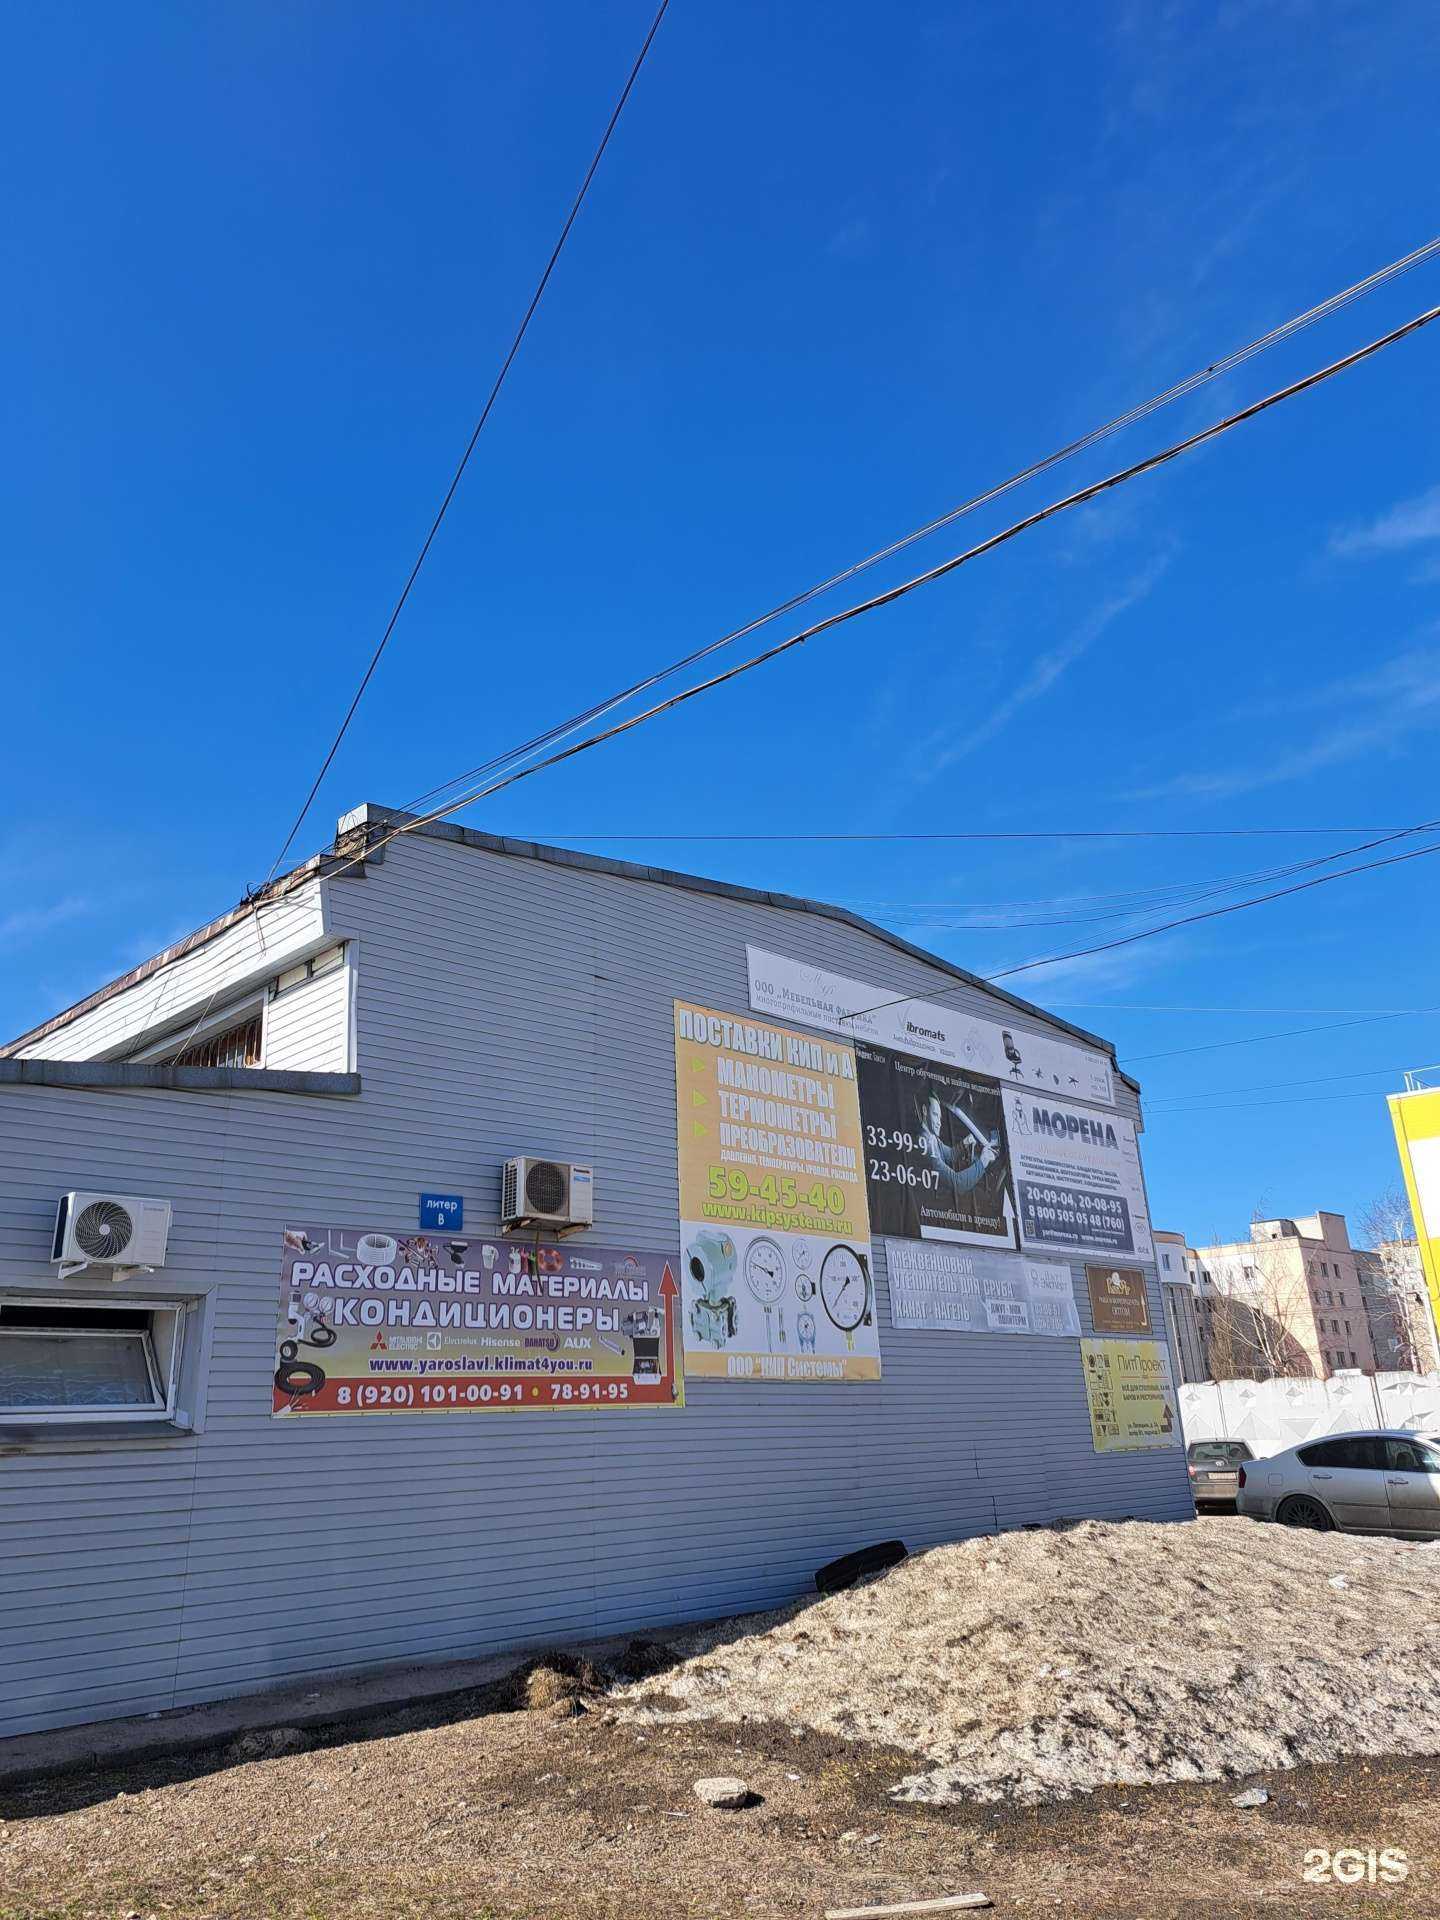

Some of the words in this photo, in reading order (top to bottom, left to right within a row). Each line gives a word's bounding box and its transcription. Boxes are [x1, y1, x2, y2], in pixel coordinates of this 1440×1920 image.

[679, 1008, 784, 1062] ПОСТАВКИ
[787, 1037, 823, 1073] КИП
[841, 1053, 854, 1081] А
[894, 1061, 916, 1077] Центр
[717, 1057, 835, 1110] МАНОМЕТРЫ
[718, 1090, 838, 1140] ТЕРМОМЕТРЫ
[1032, 1106, 1119, 1149] МОРЕНА
[719, 1122, 857, 1170] ПРЕОБРАЗОВАТЕЛИ
[866, 1125, 936, 1158] 33-99-9
[869, 1159, 940, 1191] 23-06-07
[708, 1165, 846, 1215] 59-45-40
[426, 1199, 458, 1212] литер
[920, 1204, 967, 1223] Автомобили
[1078, 1195, 1122, 1213] 20-08-95
[438, 1213, 445, 1226] В
[702, 1202, 853, 1235] www.kipsystems.ru
[1028, 1204, 1036, 1217] 8
[1037, 1206, 1056, 1220] 800
[1057, 1209, 1074, 1223] 505
[1076, 1212, 1088, 1225] 05
[1090, 1214, 1101, 1226] 48
[1102, 1215, 1125, 1231] (760)
[892, 1251, 974, 1274] МЕЖВЕНЦОВЫЙ
[291, 1261, 480, 1294] РАСХОДНЫЕ
[492, 1273, 649, 1302] МАТЕРИАЛЫ
[894, 1270, 958, 1293] УТЕПЛИТЕЛЬ
[960, 1276, 981, 1296] ДЛЯ
[983, 1280, 1014, 1297] СРУБА
[334, 1298, 619, 1333] КОНДИЦИОНЕРЫ
[896, 1300, 928, 1319] КАНАТ
[935, 1301, 971, 1321] НАГЕЛЬ
[481, 1337, 520, 1347] Hisense
[563, 1337, 592, 1349] AUX
[369, 1355, 593, 1375] www.yaroslavl.klimat4you.ru
[727, 1356, 753, 1376] ООО
[1117, 1354, 1166, 1373] ПитПроект
[337, 1387, 351, 1405] 8
[356, 1385, 414, 1406] (920)
[421, 1384, 523, 1404] 101-00-91
[551, 1383, 629, 1401] 78-91-95
